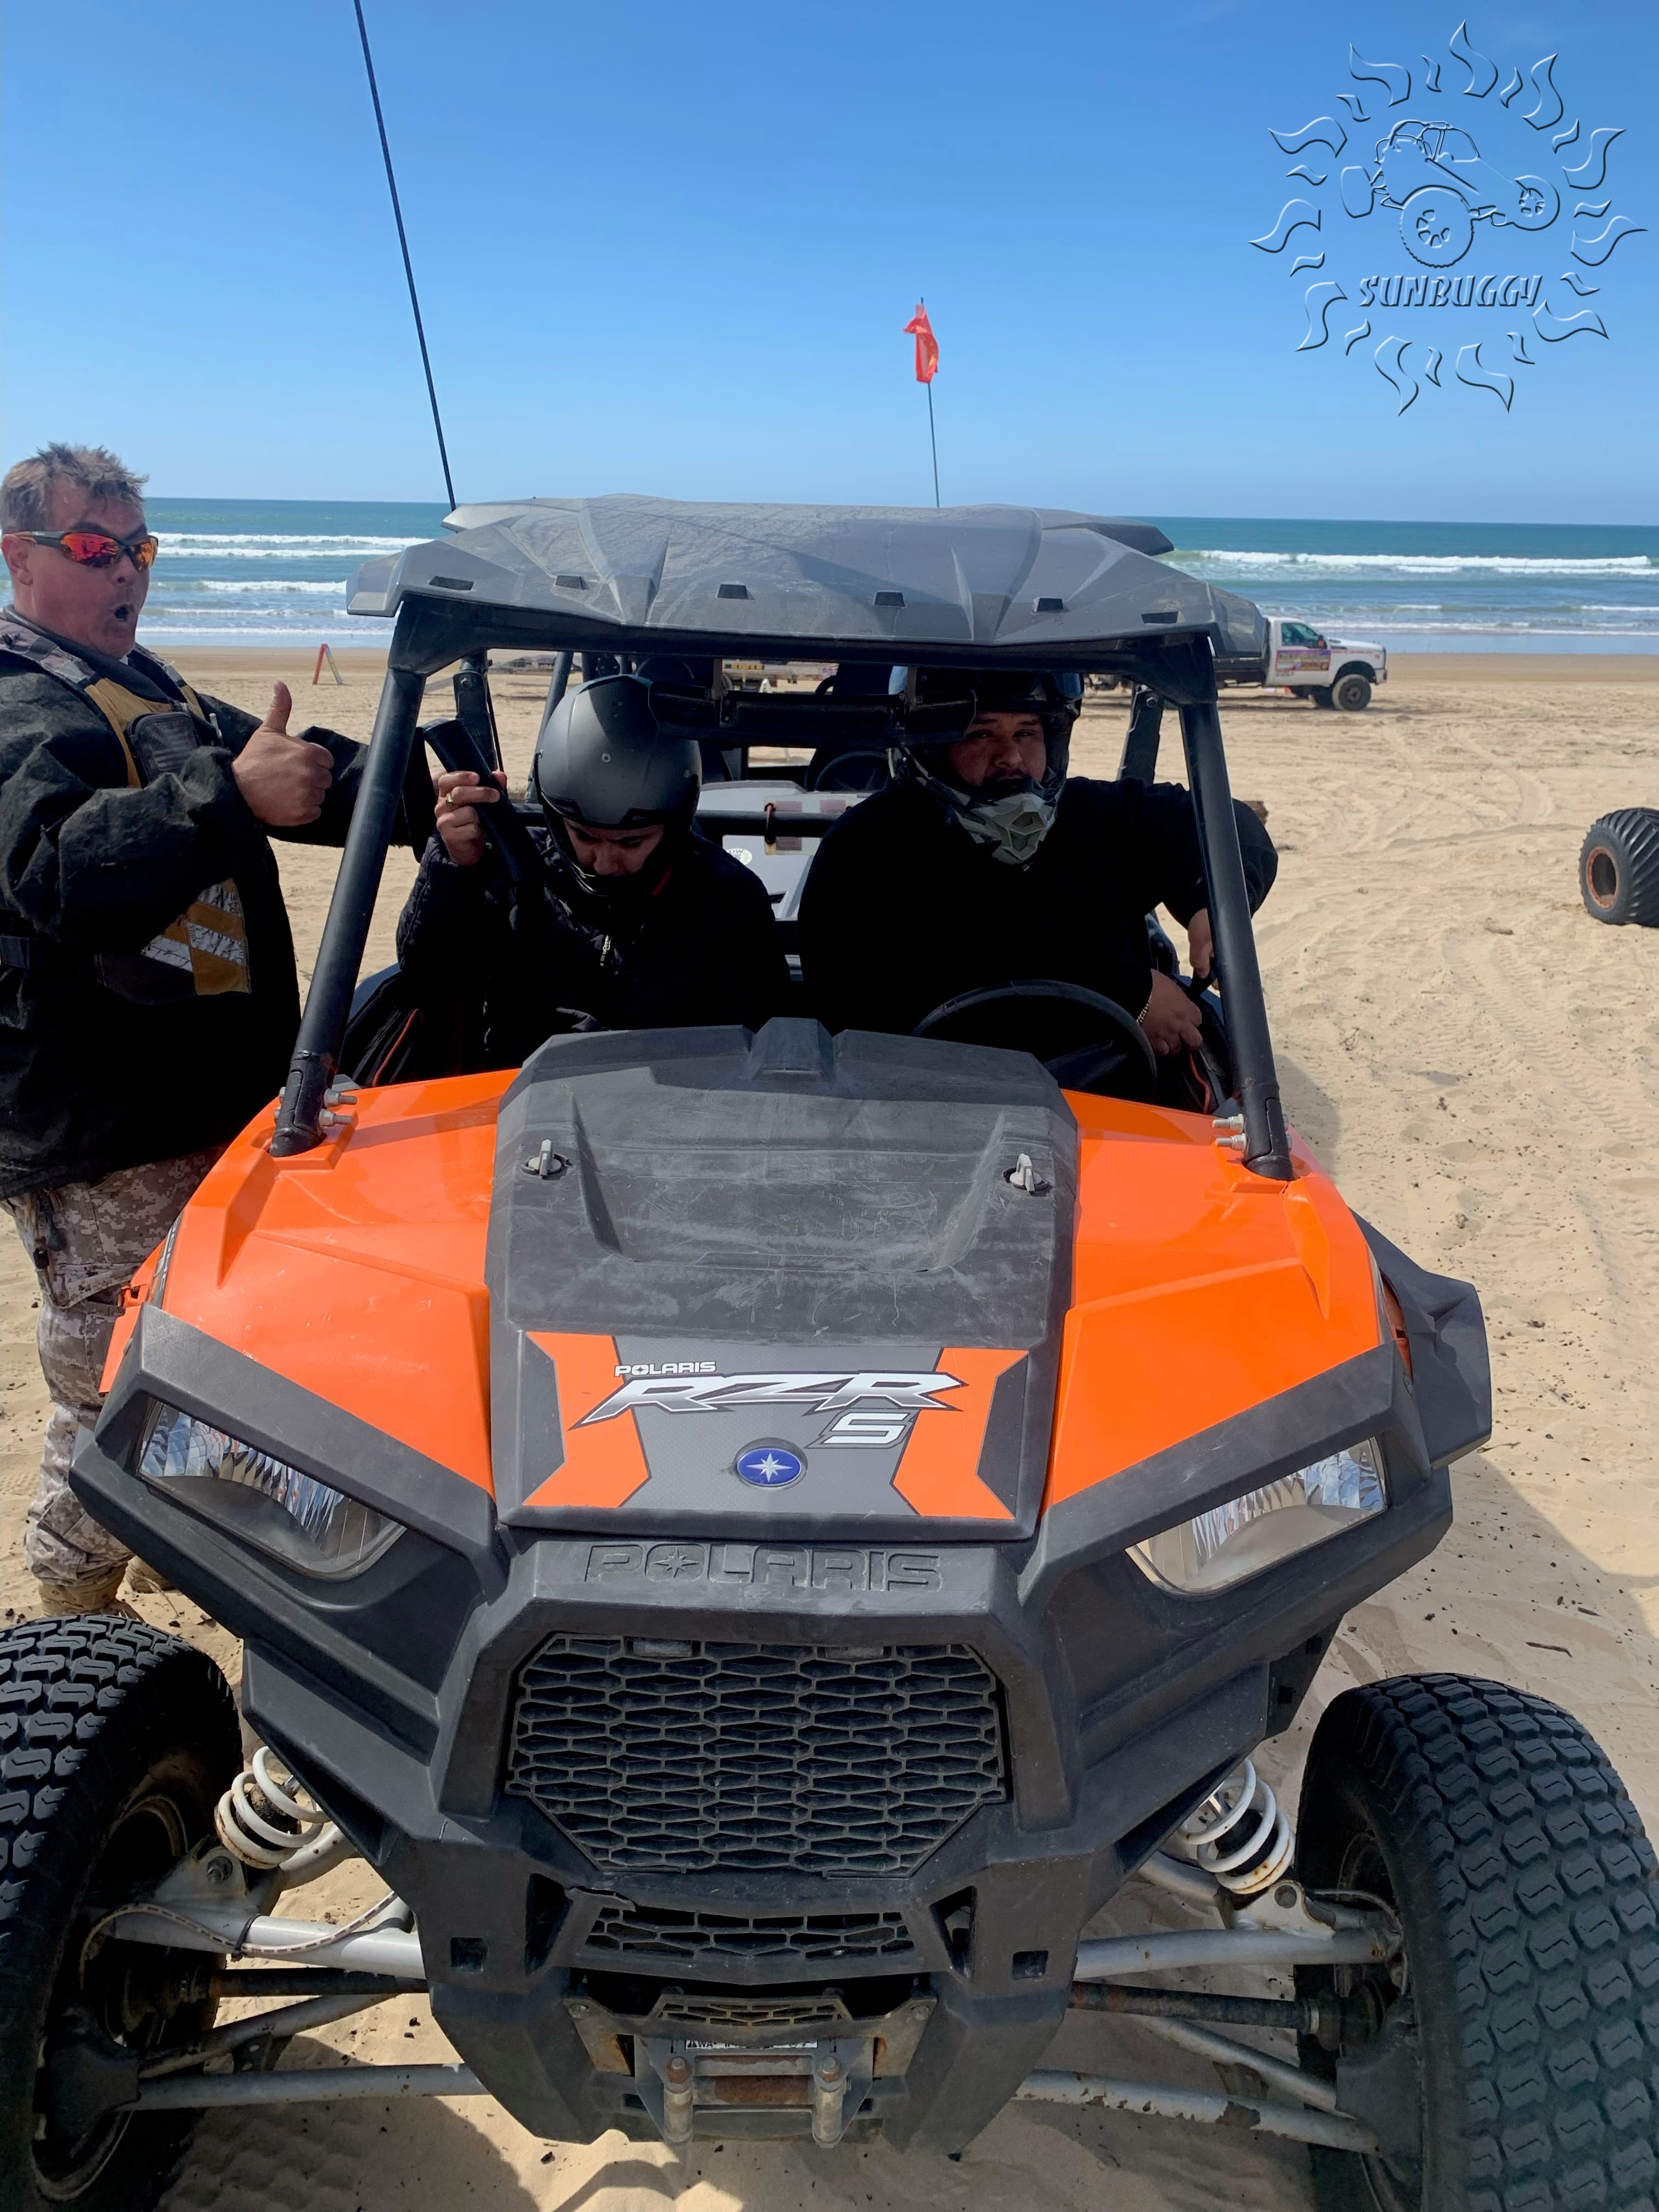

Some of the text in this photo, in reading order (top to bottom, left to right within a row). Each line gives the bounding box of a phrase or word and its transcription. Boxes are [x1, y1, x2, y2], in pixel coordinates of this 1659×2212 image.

[614, 1361, 716, 1378] POLARIS
[573, 1371, 967, 1427] RZR
[584, 1543, 943, 1592] POLARIS
